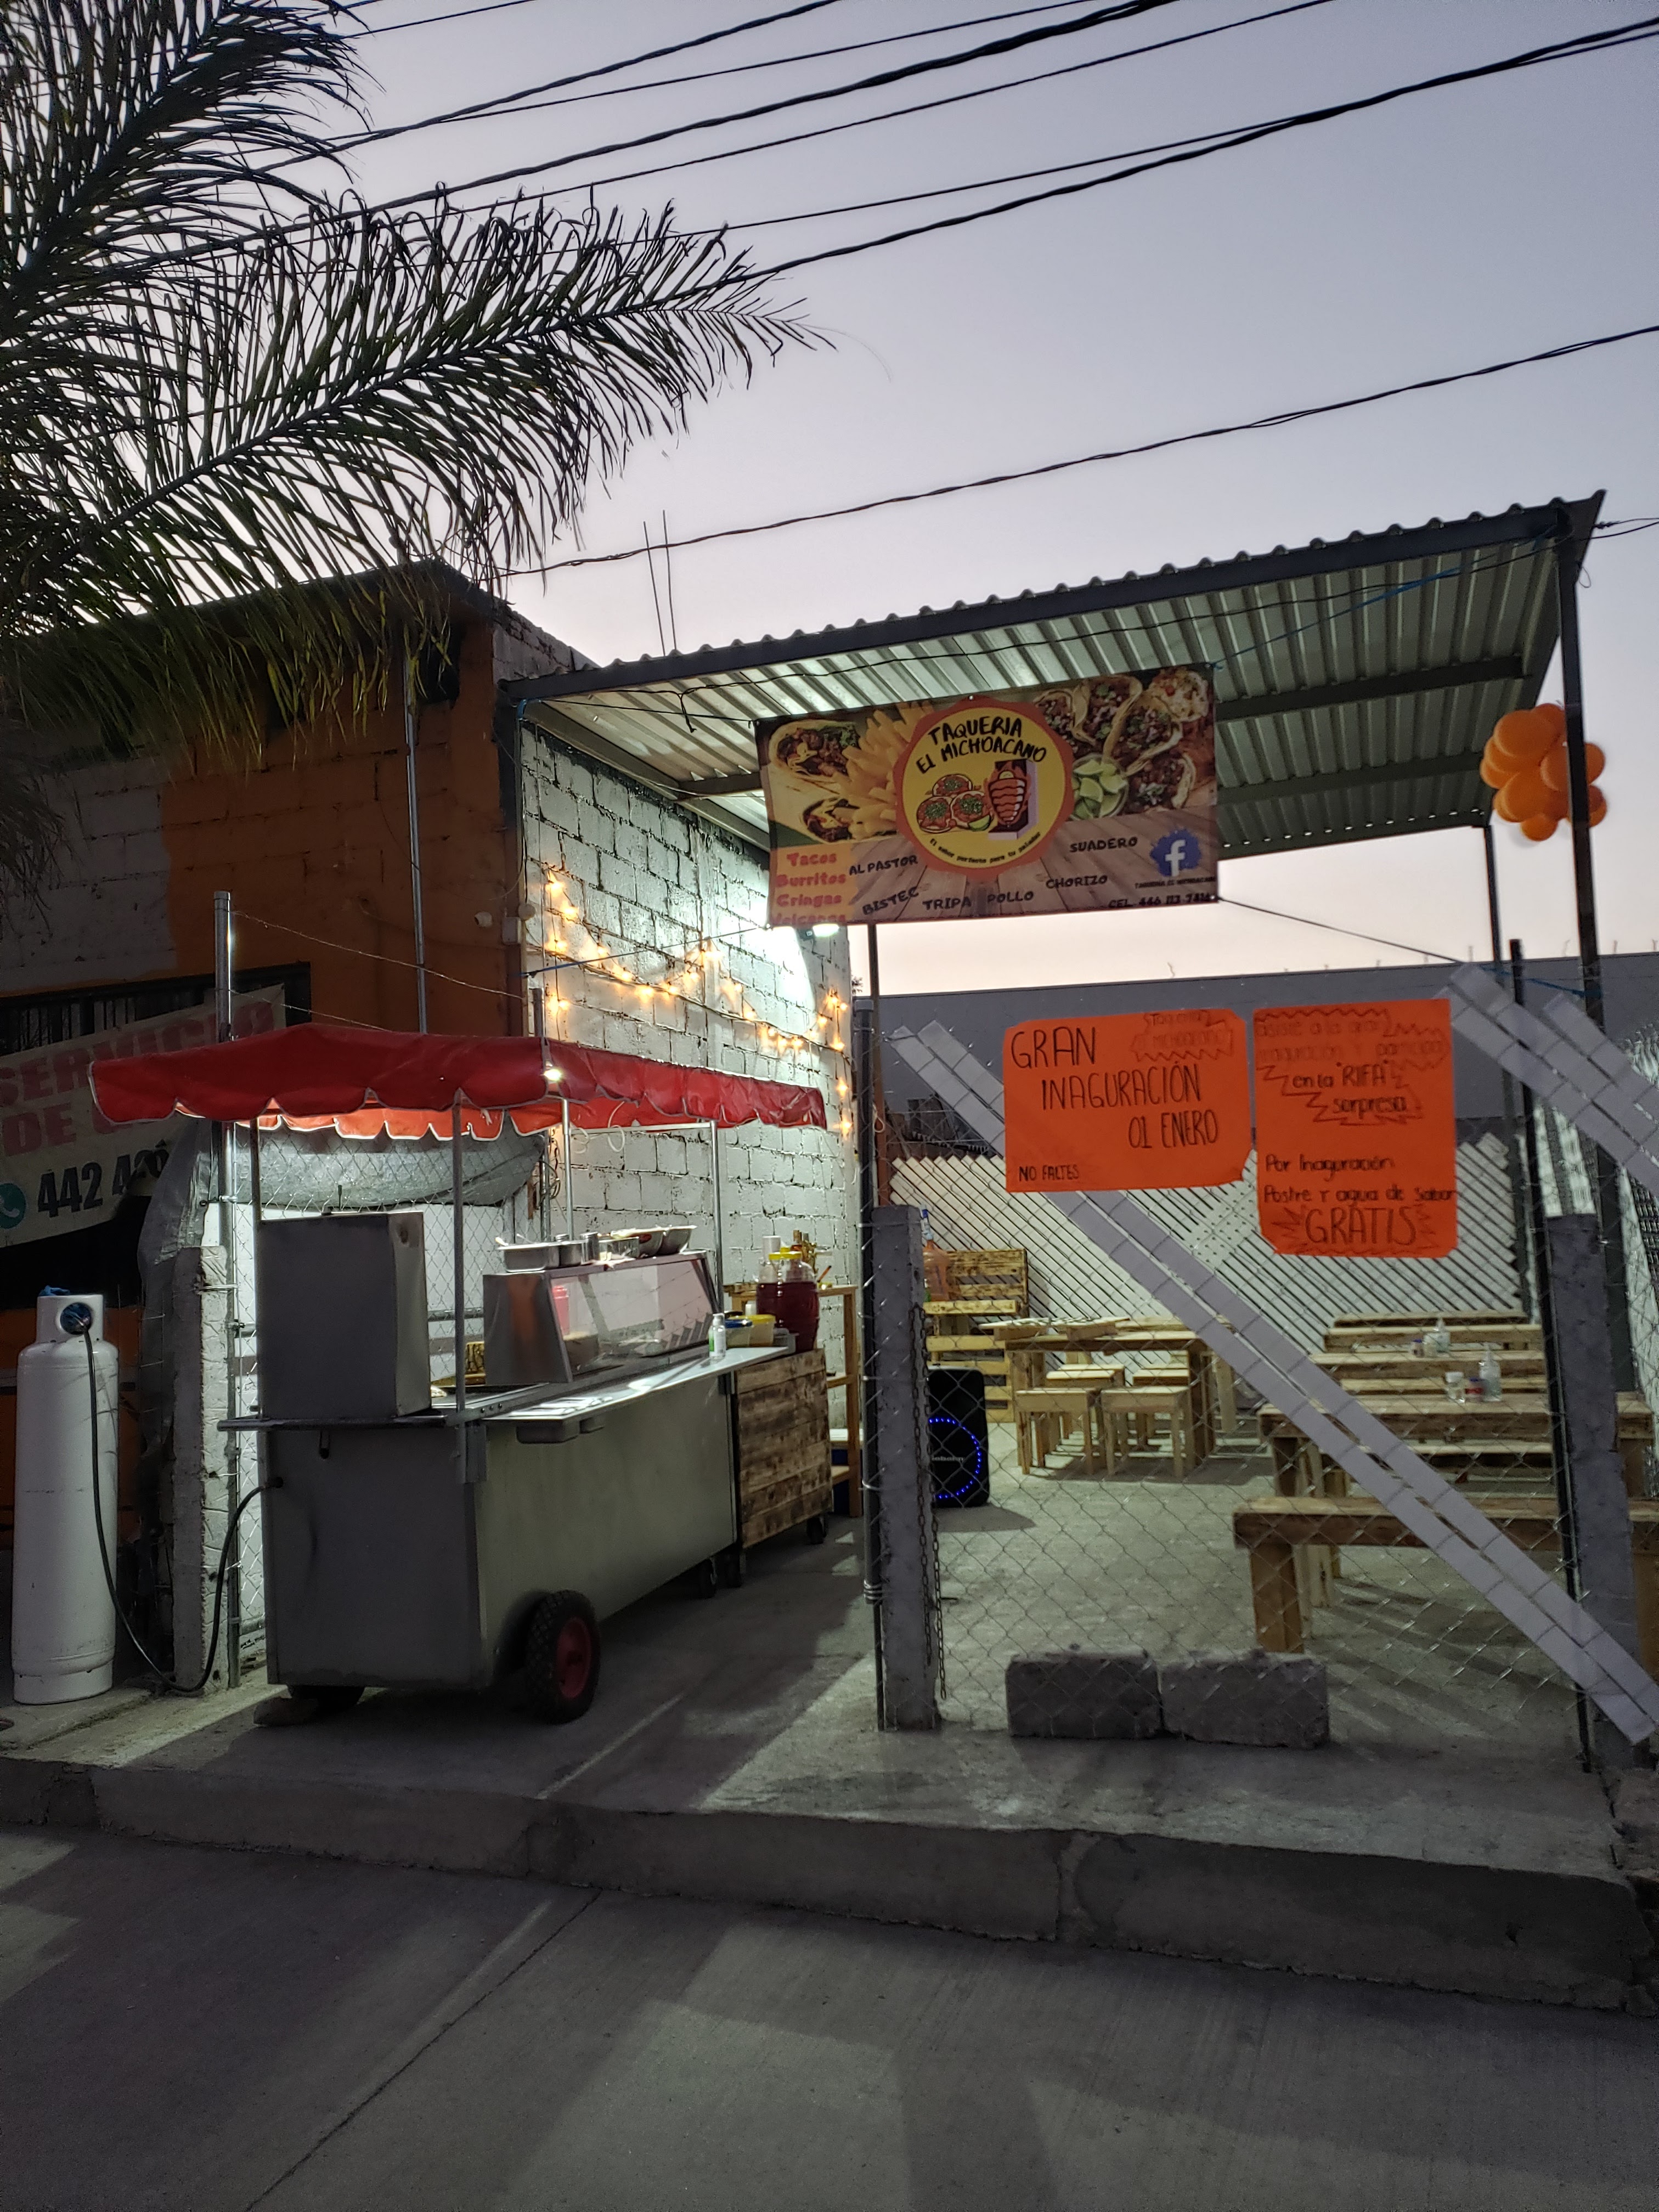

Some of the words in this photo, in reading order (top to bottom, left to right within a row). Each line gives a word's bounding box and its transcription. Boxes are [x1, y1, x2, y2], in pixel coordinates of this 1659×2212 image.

[928, 716, 1022, 745] TAQUERIA
[941, 736, 1046, 762] MICHOACANO
[1070, 837, 1138, 853] SUADERO
[786, 852, 837, 867] Tacos
[849, 864, 865, 876] AL
[867, 854, 918, 873] PASTOR
[775, 872, 847, 888] Burritos
[1045, 875, 1108, 889] CHORIZO
[776, 893, 842, 908] Gringas
[862, 885, 919, 916] BISTEC
[922, 896, 972, 911] TRIPA
[988, 890, 1034, 904] POLLO
[1011, 1026, 1096, 1069] GRAN
[1042, 1060, 1201, 1111] INAGURACIÓN
[2, 1102, 77, 1156] DE
[1161, 1109, 1218, 1148] ENERO
[1019, 1165, 1037, 1181] NO
[1042, 1164, 1080, 1180] FALTES
[1265, 1153, 1290, 1172] Por
[37, 1161, 103, 1218] 442
[1263, 1184, 1312, 1203] Postre
[1335, 1189, 1379, 1207] agua
[1385, 1182, 1404, 1201] de
[1305, 1207, 1417, 1246] GRATIS
